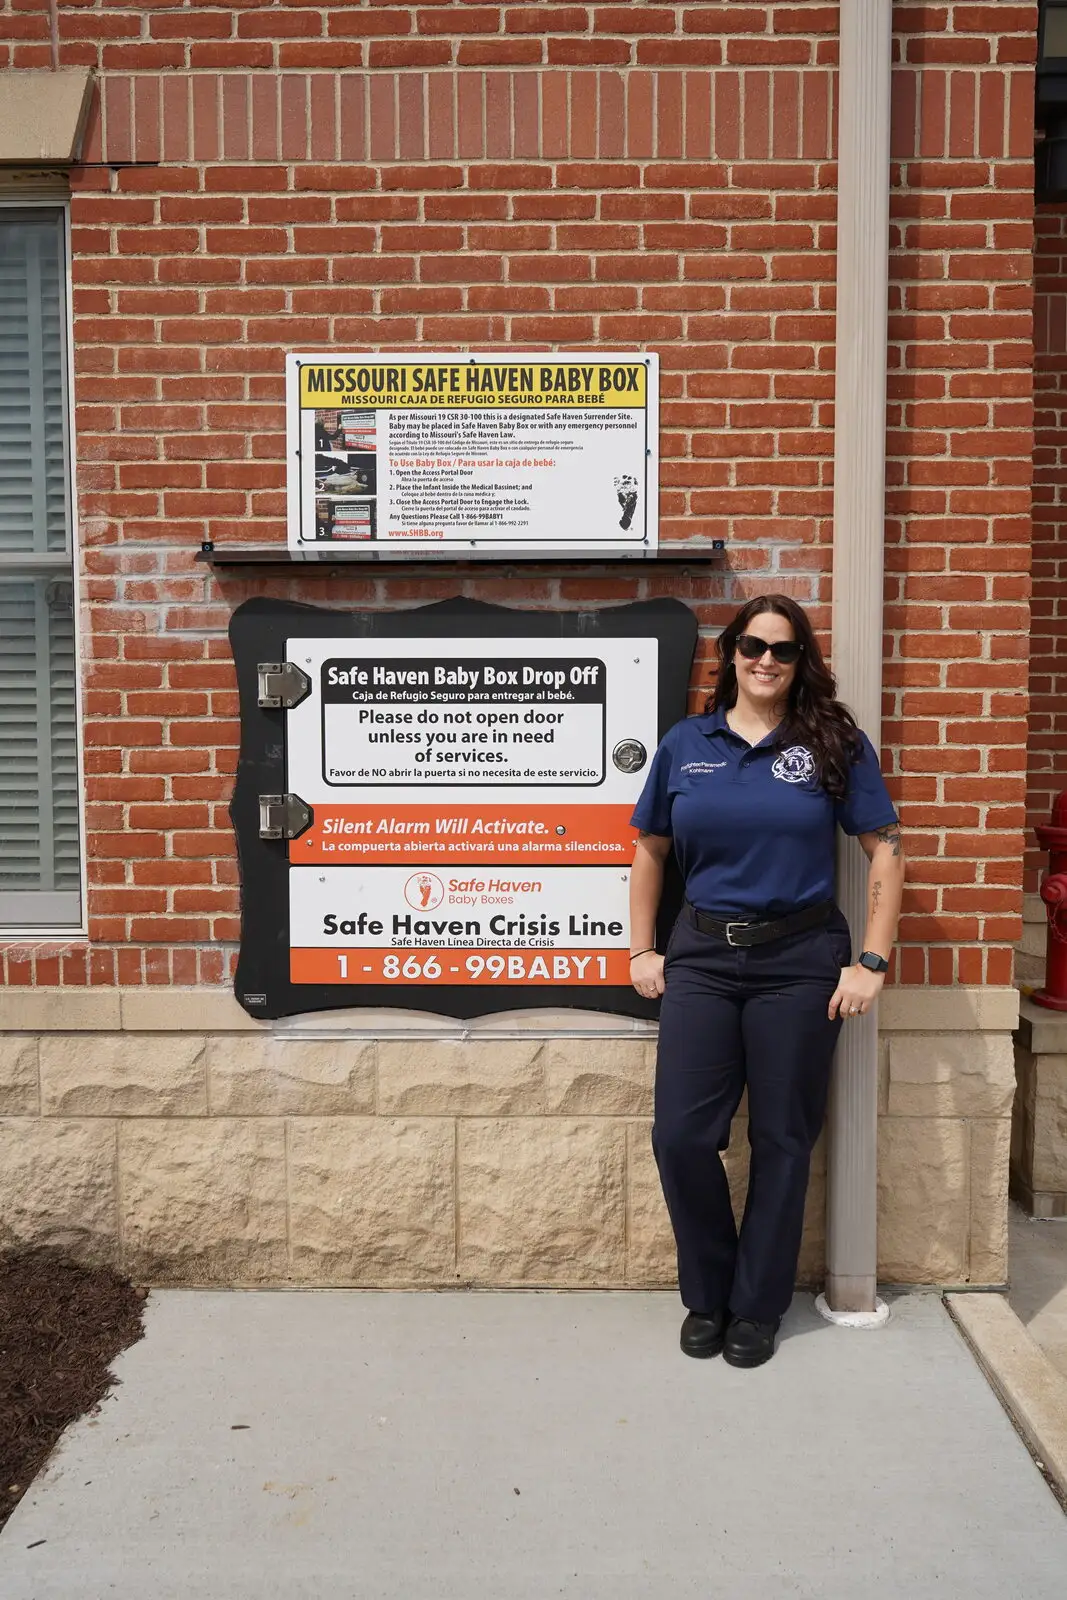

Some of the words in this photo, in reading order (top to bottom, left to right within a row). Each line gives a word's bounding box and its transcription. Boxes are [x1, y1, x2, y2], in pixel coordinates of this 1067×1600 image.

[307, 368, 407, 393] MISSOURI
[412, 367, 460, 392] SAFE
[466, 367, 534, 392] HAVEN
[540, 367, 594, 392] BABY
[599, 367, 639, 392] BOX
[341, 395, 397, 405] MISSOURI
[399, 395, 428, 404] CAJA
[430, 395, 445, 404] DE
[447, 394, 496, 404] REFUGIO
[497, 394, 543, 404] SEGURO
[545, 394, 575, 404] PARA
[577, 392, 605, 404] BEBÉ
[388, 413, 397, 421] As
[409, 413, 437, 421] Missouri
[438, 413, 446, 421] 19
[446, 413, 459, 421] CSR
[459, 413, 483, 421] 30-100
[483, 413, 496, 421] this
[508, 413, 546, 422] designated
[546, 412, 561, 421] Safe
[583, 412, 617, 421] Surrender
[617, 412, 633, 420] Site.
[389, 422, 406, 431] Baby
[406, 423, 421, 431] may
[430, 422, 453, 431] placed
[461, 422, 476, 430] Safe
[476, 422, 498, 430] Haven
[498, 422, 516, 431] Baby
[516, 422, 529, 430] Box
[537, 421, 554, 429] with
[554, 423, 567, 431] any
[567, 423, 604, 431] emergency
[604, 421, 638, 431] personnel
[388, 431, 421, 440] according
[429, 430, 462, 439] Missouri's
[462, 431, 477, 439] Safe
[478, 431, 499, 439] Haven
[319, 439, 324, 448] 1
[388, 458, 399, 468] To
[400, 458, 415, 467] Use
[415, 458, 436, 469] Baby
[436, 458, 452, 467] Box
[457, 458, 476, 467] Para
[495, 458, 504, 467] la
[504, 458, 521, 469] caja
[521, 458, 533, 467] de
[533, 458, 556, 467] bebé:
[395, 469, 411, 477] Open
[319, 483, 325, 492] 2
[395, 483, 412, 491] Place
[411, 483, 422, 491] the
[422, 483, 441, 491] Infant
[471, 483, 494, 491] Medical
[494, 483, 521, 491] Bassinet;
[481, 498, 503, 507] Engage
[389, 513, 401, 521] Any
[400, 513, 430, 521] Questions
[319, 527, 325, 536] 3
[388, 528, 444, 539] www.SHBB.org
[328, 666, 369, 685] Safe
[373, 666, 429, 685] Haven
[434, 666, 480, 690] Baby
[483, 666, 518, 685] Box
[522, 666, 566, 690] Drop
[569, 665, 599, 685] Off
[352, 690, 374, 702] Caja
[375, 690, 389, 700] de
[390, 690, 429, 702] Refugio
[430, 691, 466, 702] Seguro
[467, 692, 490, 702] para
[491, 691, 535, 702] entregar
[536, 690, 545, 700] al
[547, 689, 575, 700] bebé.
[359, 709, 413, 724] Please
[417, 709, 439, 724] do
[443, 711, 472, 724] not
[476, 713, 519, 728] open
[523, 709, 565, 724] door
[368, 728, 422, 744] unless
[425, 732, 457, 747] you
[461, 732, 488, 743] are
[492, 728, 508, 743] in
[512, 728, 554, 743] need
[415, 748, 433, 763] of
[436, 748, 508, 763] services.
[329, 768, 356, 777] Favor
[357, 768, 370, 777] de
[371, 768, 387, 777] NO
[388, 768, 412, 777] abrir
[413, 768, 423, 777] la
[424, 769, 456, 779] puerta
[458, 768, 466, 777] si
[482, 768, 522, 777] necesita
[523, 768, 536, 777] de
[537, 769, 558, 777] este
[559, 768, 599, 777] servicio.
[322, 818, 374, 834] Silent
[375, 818, 431, 834] Alarm
[435, 818, 469, 834] Will
[470, 818, 549, 834] Activate.
[322, 841, 336, 852] La
[337, 842, 402, 854] compuerta
[403, 840, 446, 852] abierta
[447, 840, 495, 851] activará
[497, 843, 520, 852] una
[521, 841, 563, 852] alarma
[564, 840, 625, 852] silenciosa.
[448, 878, 486, 893] Safe
[487, 879, 542, 893] Haven
[448, 894, 478, 907] Baby
[480, 894, 514, 905] Boxes
[323, 912, 384, 936] Safe
[392, 914, 481, 936] Haven
[489, 913, 561, 936] Crisis
[569, 913, 623, 937] Line
[391, 937, 413, 947] Safe
[414, 937, 446, 947] Haven
[447, 937, 474, 947] Línea
[476, 937, 512, 947] Directa
[513, 937, 527, 947] de
[528, 937, 555, 947] Crisis
[337, 955, 348, 978] 1
[382, 954, 442, 979] 866
[465, 955, 607, 979] 99BABY1
